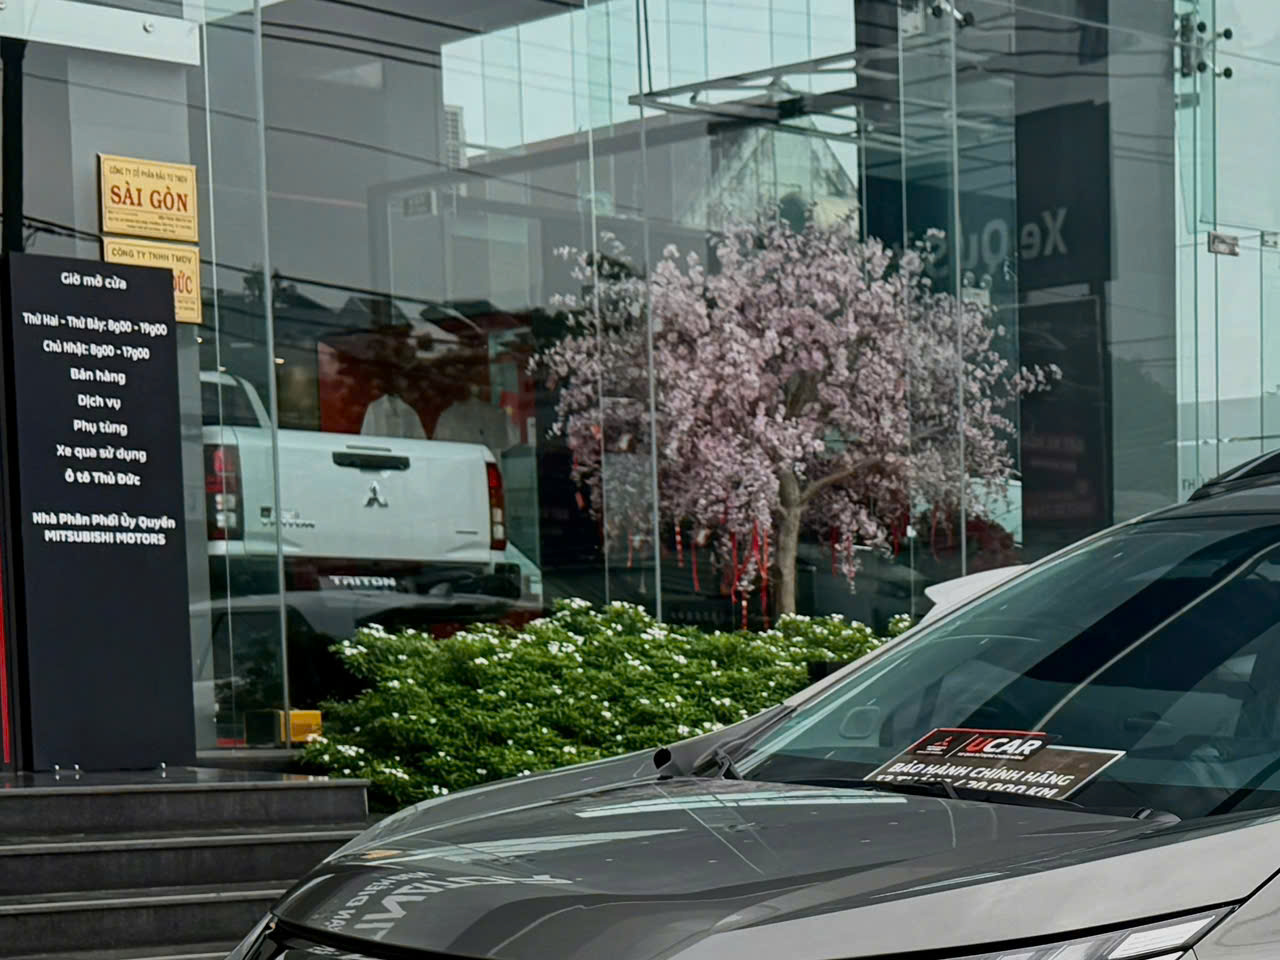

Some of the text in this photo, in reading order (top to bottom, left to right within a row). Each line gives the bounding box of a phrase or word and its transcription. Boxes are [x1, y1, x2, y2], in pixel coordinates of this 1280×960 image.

[110, 181, 189, 213] SÀI GÒN
[136, 250, 146, 260] TY
[60, 271, 128, 290] Giờ mở cửa
[174, 270, 193, 294] ỨC
[43, 314, 59, 327] Hai
[108, 319, 132, 335] 8g00
[140, 322, 168, 337] 19g00
[43, 339, 62, 353] Chủ
[90, 343, 115, 358] 8g00
[122, 346, 150, 361] 17g00
[70, 367, 126, 386] Bán hàng
[77, 394, 121, 411] Dịch vụ
[73, 419, 128, 437] Phụ tùng
[56, 443, 147, 464] Xe qua sử dụng
[64, 467, 141, 486] Ô tô Thủ Đức
[32, 511, 58, 525] Nhà
[58, 512, 90, 526] Phân
[44, 529, 167, 545] MITSUBISHI MOTORS
[329, 575, 396, 588] TRITON
[966, 737, 1043, 755] UCAR
[887, 760, 924, 773] BẢO
[922, 762, 971, 777] HÀNH
[969, 766, 1022, 781] CHÍNH
[1021, 770, 1075, 787] HÃNG
